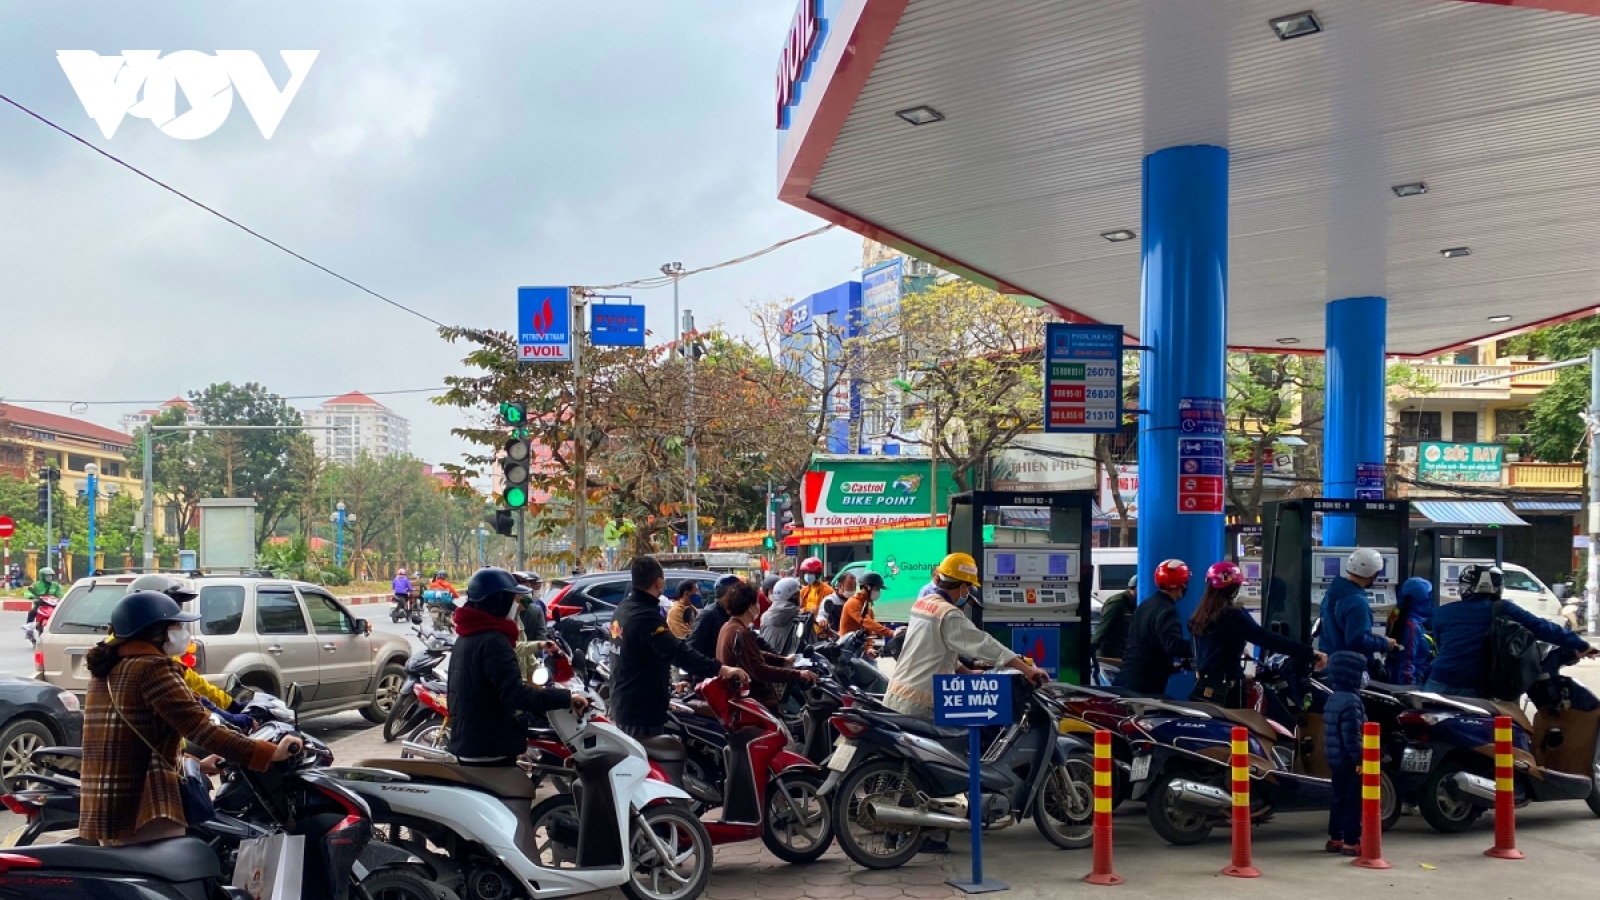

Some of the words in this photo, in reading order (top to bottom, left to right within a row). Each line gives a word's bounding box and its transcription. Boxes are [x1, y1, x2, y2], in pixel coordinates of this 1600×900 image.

[595, 314, 638, 326] PVOIL
[523, 345, 563, 357] PVOIL
[1086, 367, 1116, 378] 26070
[1086, 389, 1116, 399] 26830
[1086, 411, 1114, 420] 21310
[1443, 444, 1470, 462] SÓC
[1472, 446, 1500, 462] BAY
[1011, 458, 1049, 474] THIÊN
[852, 483, 884, 493] Castrol
[842, 496, 872, 506] BIKE
[876, 496, 917, 506] POINT
[813, 517, 824, 526] TT
[826, 515, 842, 526] SỬA
[843, 515, 868, 526] CHỮA
[942, 676, 965, 691] LỐI
[971, 677, 999, 691] VÀO
[943, 694, 963, 707] XE
[968, 692, 1000, 706] MÁY
